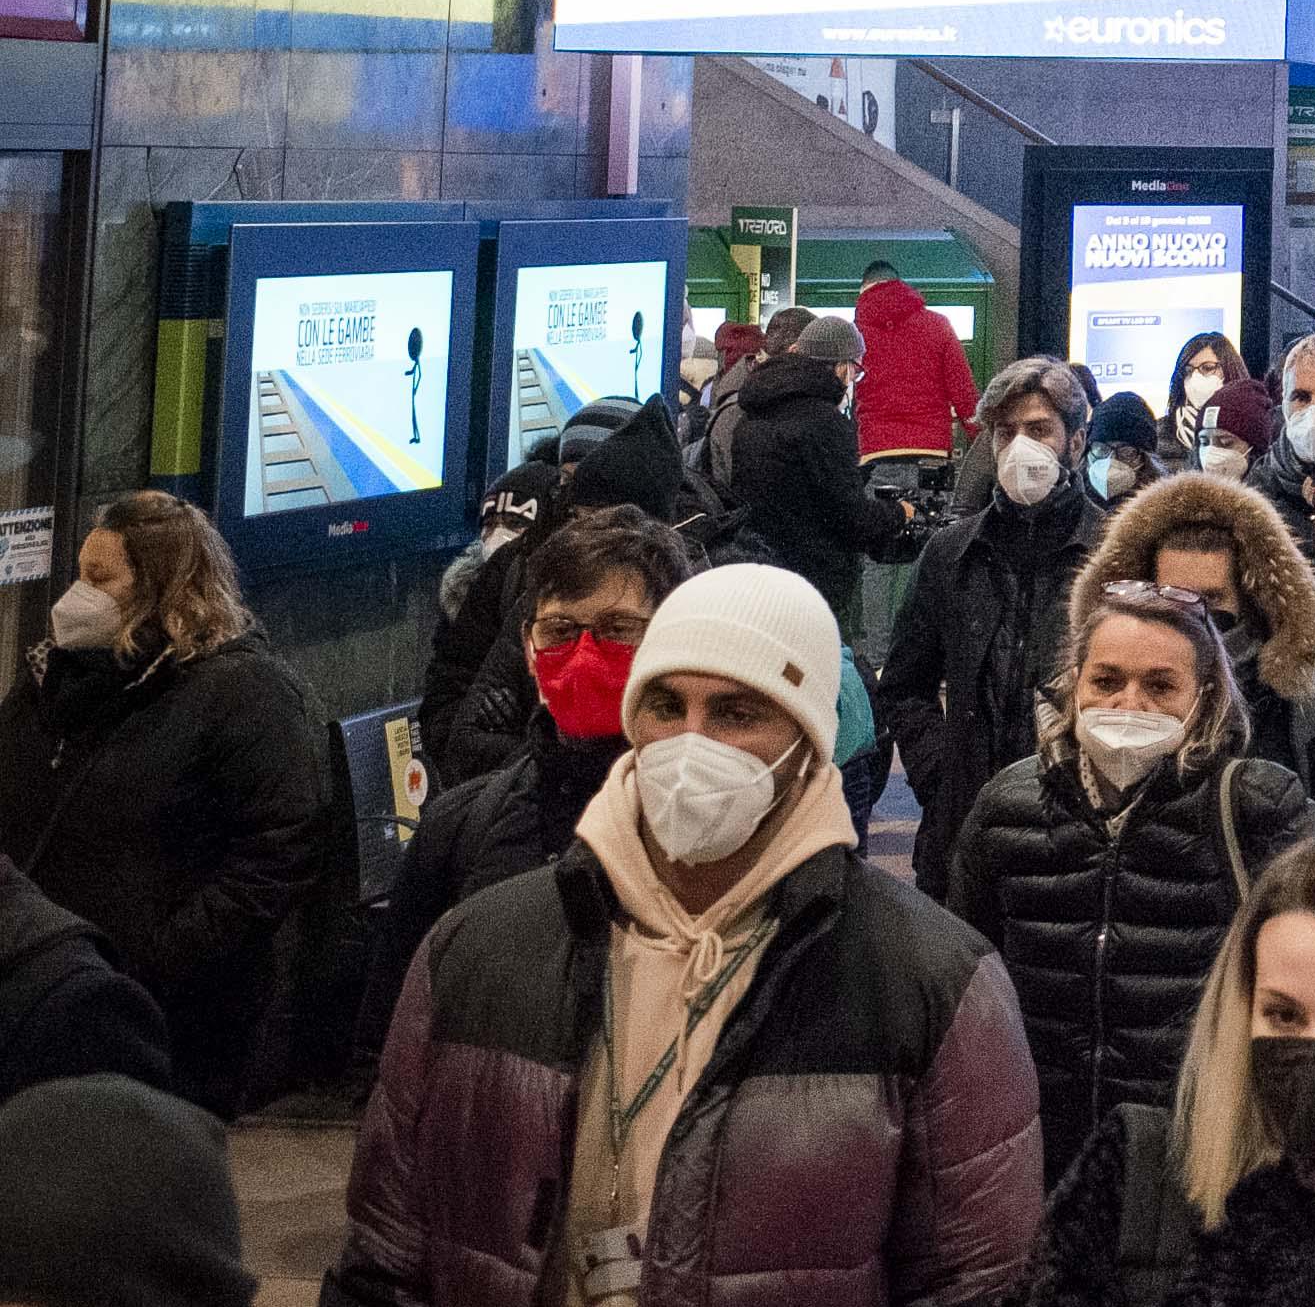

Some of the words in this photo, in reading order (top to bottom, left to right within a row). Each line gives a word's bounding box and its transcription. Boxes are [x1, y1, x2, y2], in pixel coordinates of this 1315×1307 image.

[1068, 10, 1227, 46] euronics
[745, 219, 788, 235] TRENORD
[1087, 233, 1149, 251] ANNO
[1150, 233, 1227, 251] NUOVO
[1085, 249, 1149, 268] NUOVI
[1150, 249, 1226, 268] SCONTI
[548, 304, 564, 328] CON
[567, 303, 576, 327] LE
[578, 301, 608, 326] GAMBE
[298, 318, 319, 348] CON
[323, 318, 335, 346] LE
[338, 315, 376, 345] GAMBE
[482, 492, 538, 521] FILA
